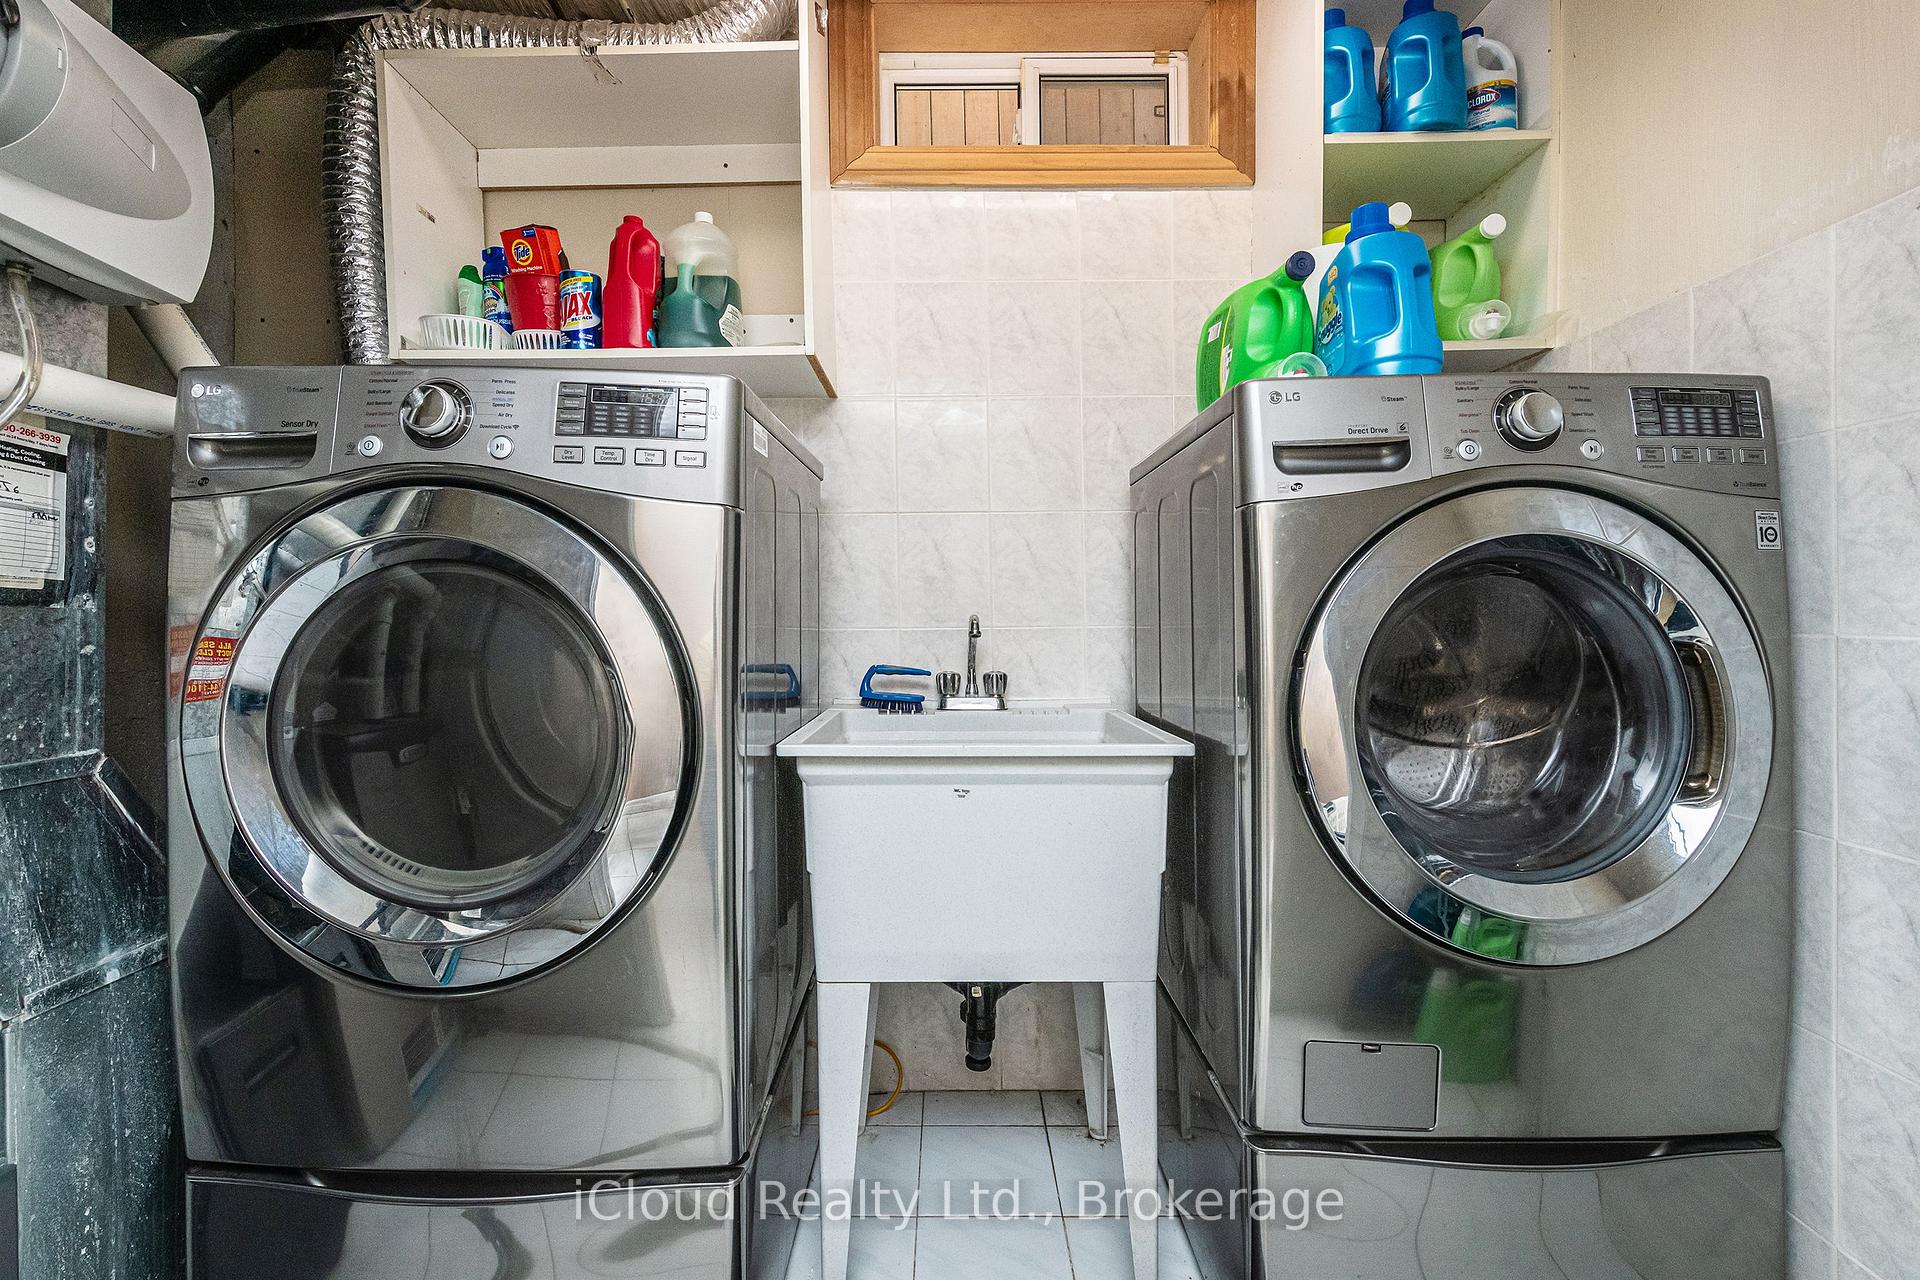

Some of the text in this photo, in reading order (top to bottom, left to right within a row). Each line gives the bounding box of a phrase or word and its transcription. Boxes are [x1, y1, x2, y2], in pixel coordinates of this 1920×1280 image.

[1467, 92, 1496, 109] CLOROX
[513, 244, 530, 262] Tide
[560, 291, 592, 328] JAX
[206, 384, 222, 396] LG
[1284, 392, 1301, 402] LG
[34, 404, 74, 418] SYSTEM
[280, 420, 318, 429] Sensor Dry
[20, 448, 42, 459] Cooling,
[24, 456, 46, 466] Cleaning
[1759, 526, 1778, 543] 10
